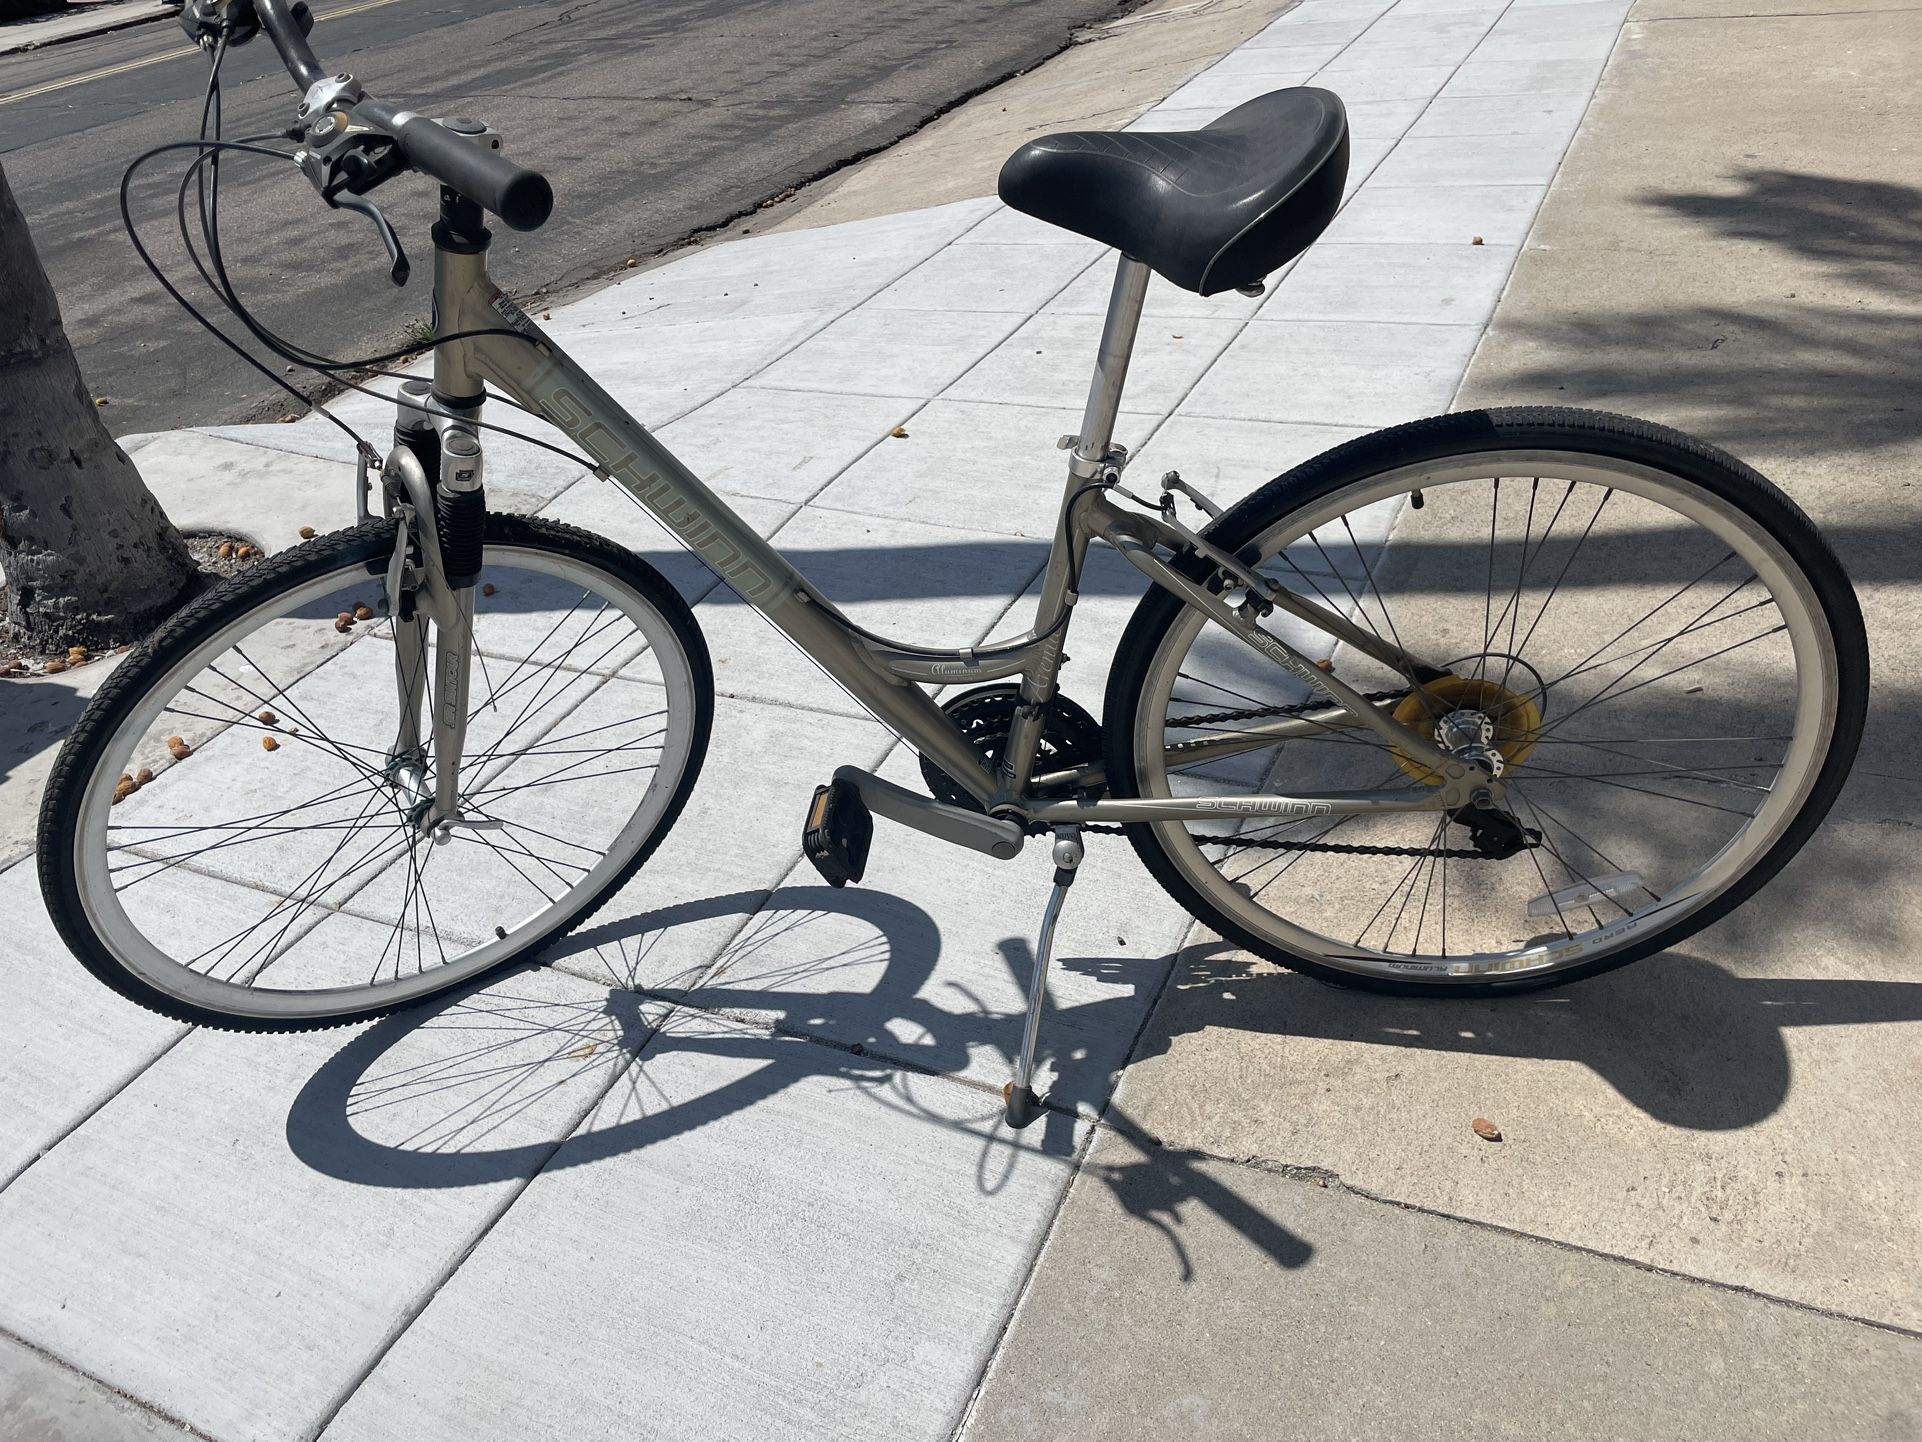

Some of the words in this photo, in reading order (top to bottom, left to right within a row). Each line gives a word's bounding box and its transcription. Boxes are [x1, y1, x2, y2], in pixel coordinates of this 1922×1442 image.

[539, 387, 773, 599] SCHWINN
[1196, 796, 1332, 815] SCHWINN
[1388, 962, 1447, 973] ALUMINUM
[1455, 942, 1584, 974] SCHWINN
